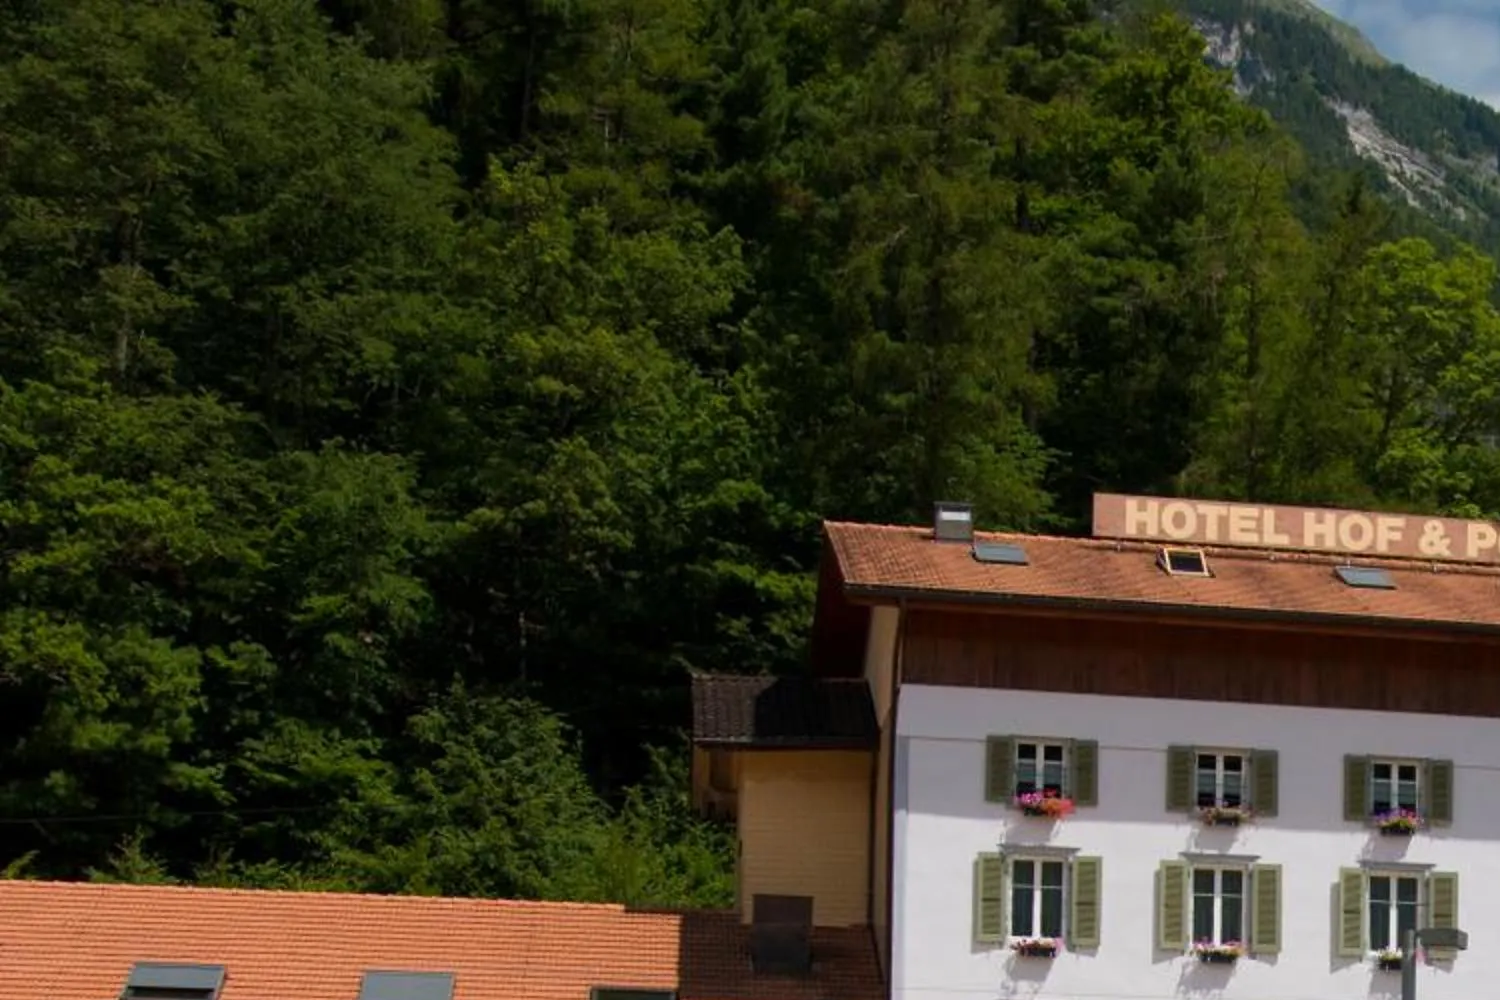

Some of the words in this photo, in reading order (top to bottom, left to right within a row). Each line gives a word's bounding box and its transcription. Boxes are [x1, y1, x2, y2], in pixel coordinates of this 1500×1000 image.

[1125, 498, 1290, 545] HOTEL
[1303, 511, 1407, 551] HOF
[1418, 519, 1453, 557] &
